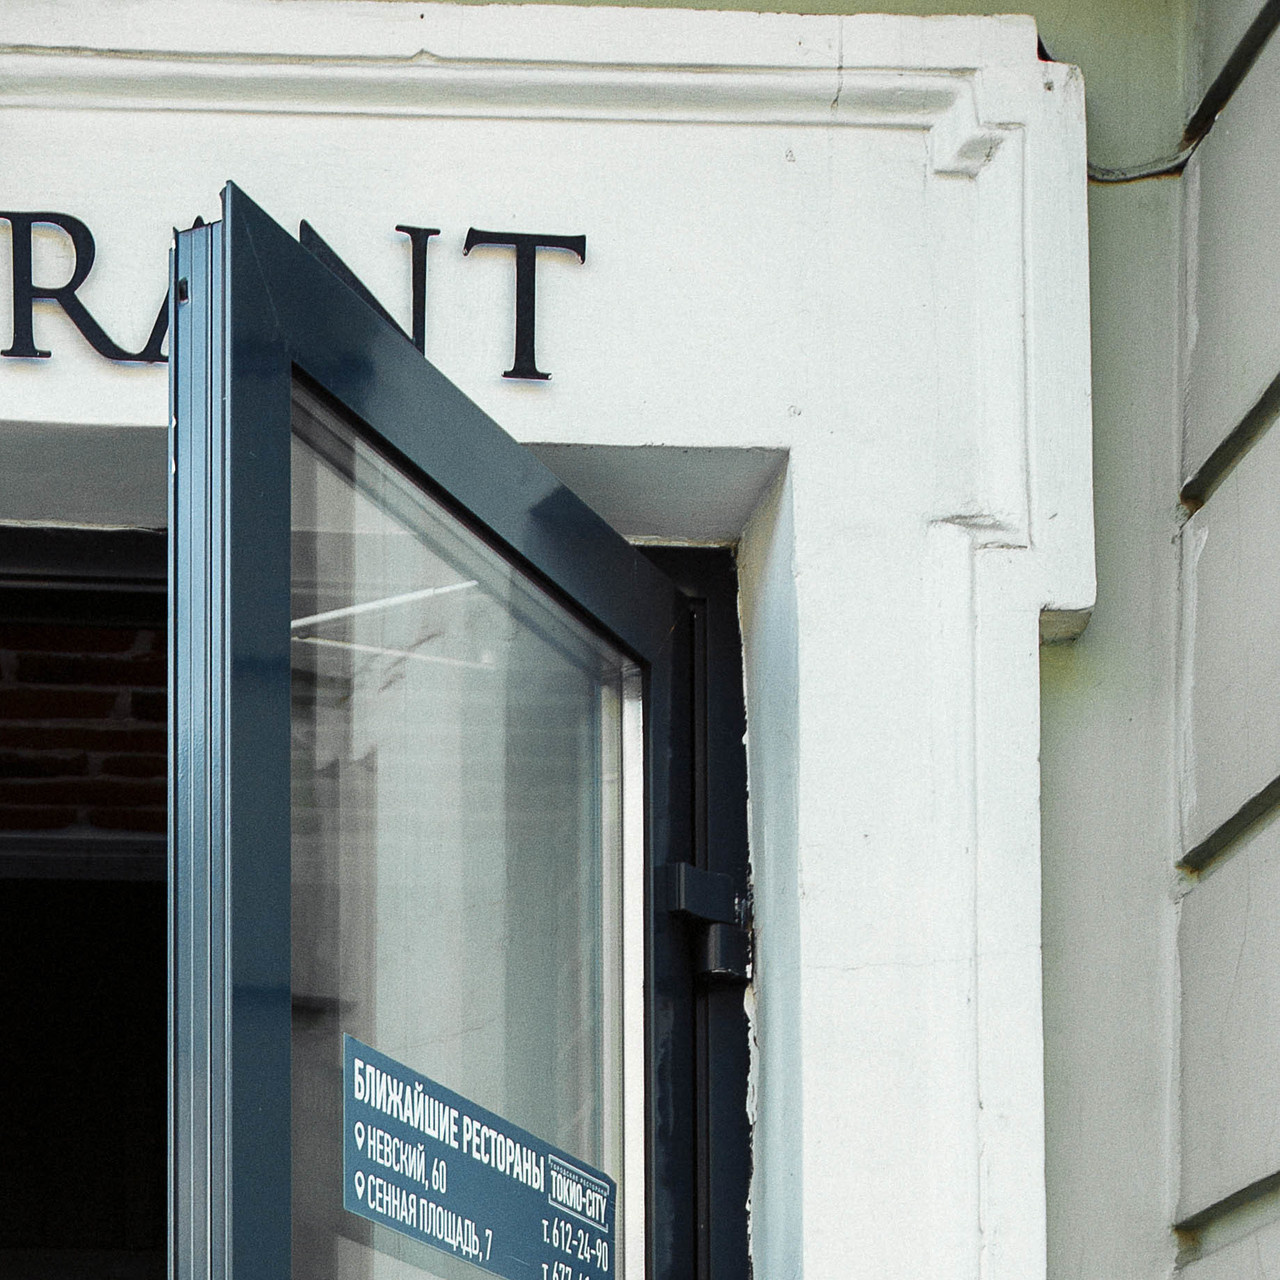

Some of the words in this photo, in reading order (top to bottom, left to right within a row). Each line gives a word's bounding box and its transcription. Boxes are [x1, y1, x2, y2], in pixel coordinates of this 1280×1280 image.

[354, 1058, 459, 1149] БЛИЖАЙШИЕ
[462, 1114, 545, 1192] РЕСТОРАНЫ
[368, 1125, 429, 1190] НЕВСКИЙ,
[431, 1158, 447, 1194] 60
[368, 1174, 417, 1228] СЕННАЯ
[419, 1198, 483, 1262] ПЛОЩАДЬ,
[485, 1228, 493, 1261] 7
[552, 1217, 609, 1272] 612-24-90
